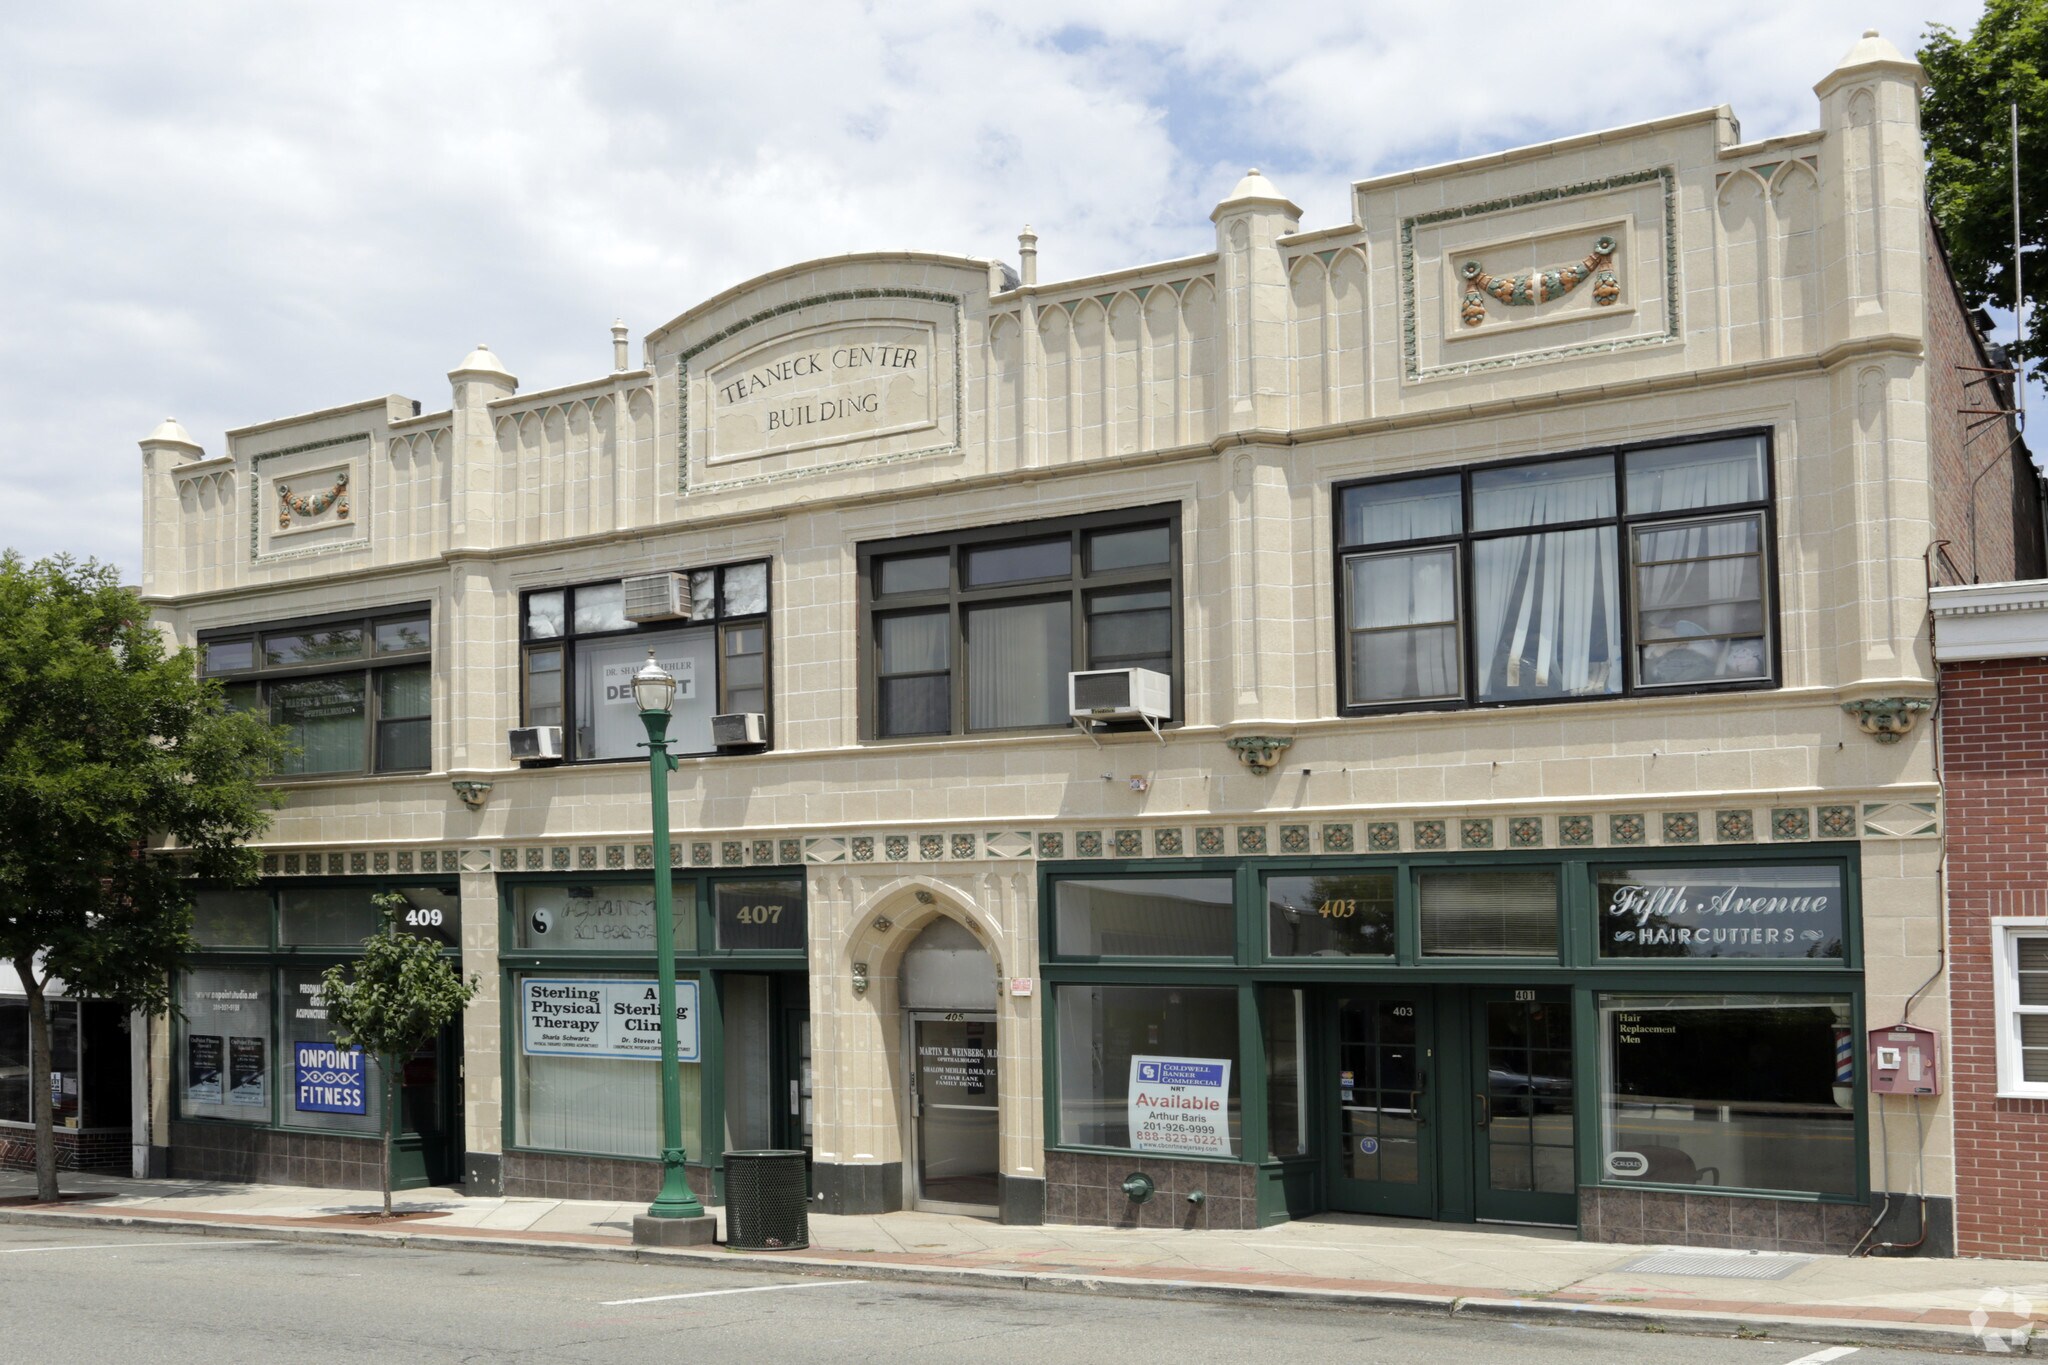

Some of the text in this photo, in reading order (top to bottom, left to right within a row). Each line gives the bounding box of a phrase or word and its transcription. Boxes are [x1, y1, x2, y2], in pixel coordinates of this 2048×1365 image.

[720, 346, 918, 404] TEANECK CENTER
[768, 393, 879, 431] BUILDING
[1319, 898, 1356, 919] 403
[1609, 884, 1828, 926] Fifth Avenue
[406, 908, 443, 927] 409
[737, 905, 783, 924] 407
[1639, 927, 1795, 945] HAIRCUTTERS
[531, 986, 600, 1002] Sterling
[1516, 990, 1535, 1000] 401
[531, 1001, 601, 1016] Physical
[614, 1002, 688, 1019] Sterlig
[1393, 1007, 1413, 1017] 403
[532, 1016, 600, 1032] Therapy
[945, 1013, 965, 1021] 405
[1619, 1013, 1641, 1022] Hair
[625, 1018, 662, 1032] Clin
[1620, 1024, 1676, 1034] Replacement
[1620, 1035, 1641, 1044] Men
[300, 1048, 360, 1070] ONPOINT
[919, 1046, 942, 1055] MARTIN
[952, 1047, 986, 1058] WEINBERG,
[1163, 1064, 1211, 1073] COLDWELL
[1162, 1077, 1220, 1086] COMMERCIAL
[300, 1086, 361, 1108] FITNESS
[1136, 1093, 1220, 1111] Available
[1149, 1111, 1207, 1123] Arthur Baris
[1143, 1121, 1215, 1134] 201-926-9999
[1136, 1131, 1224, 1146] 888-829-0221
